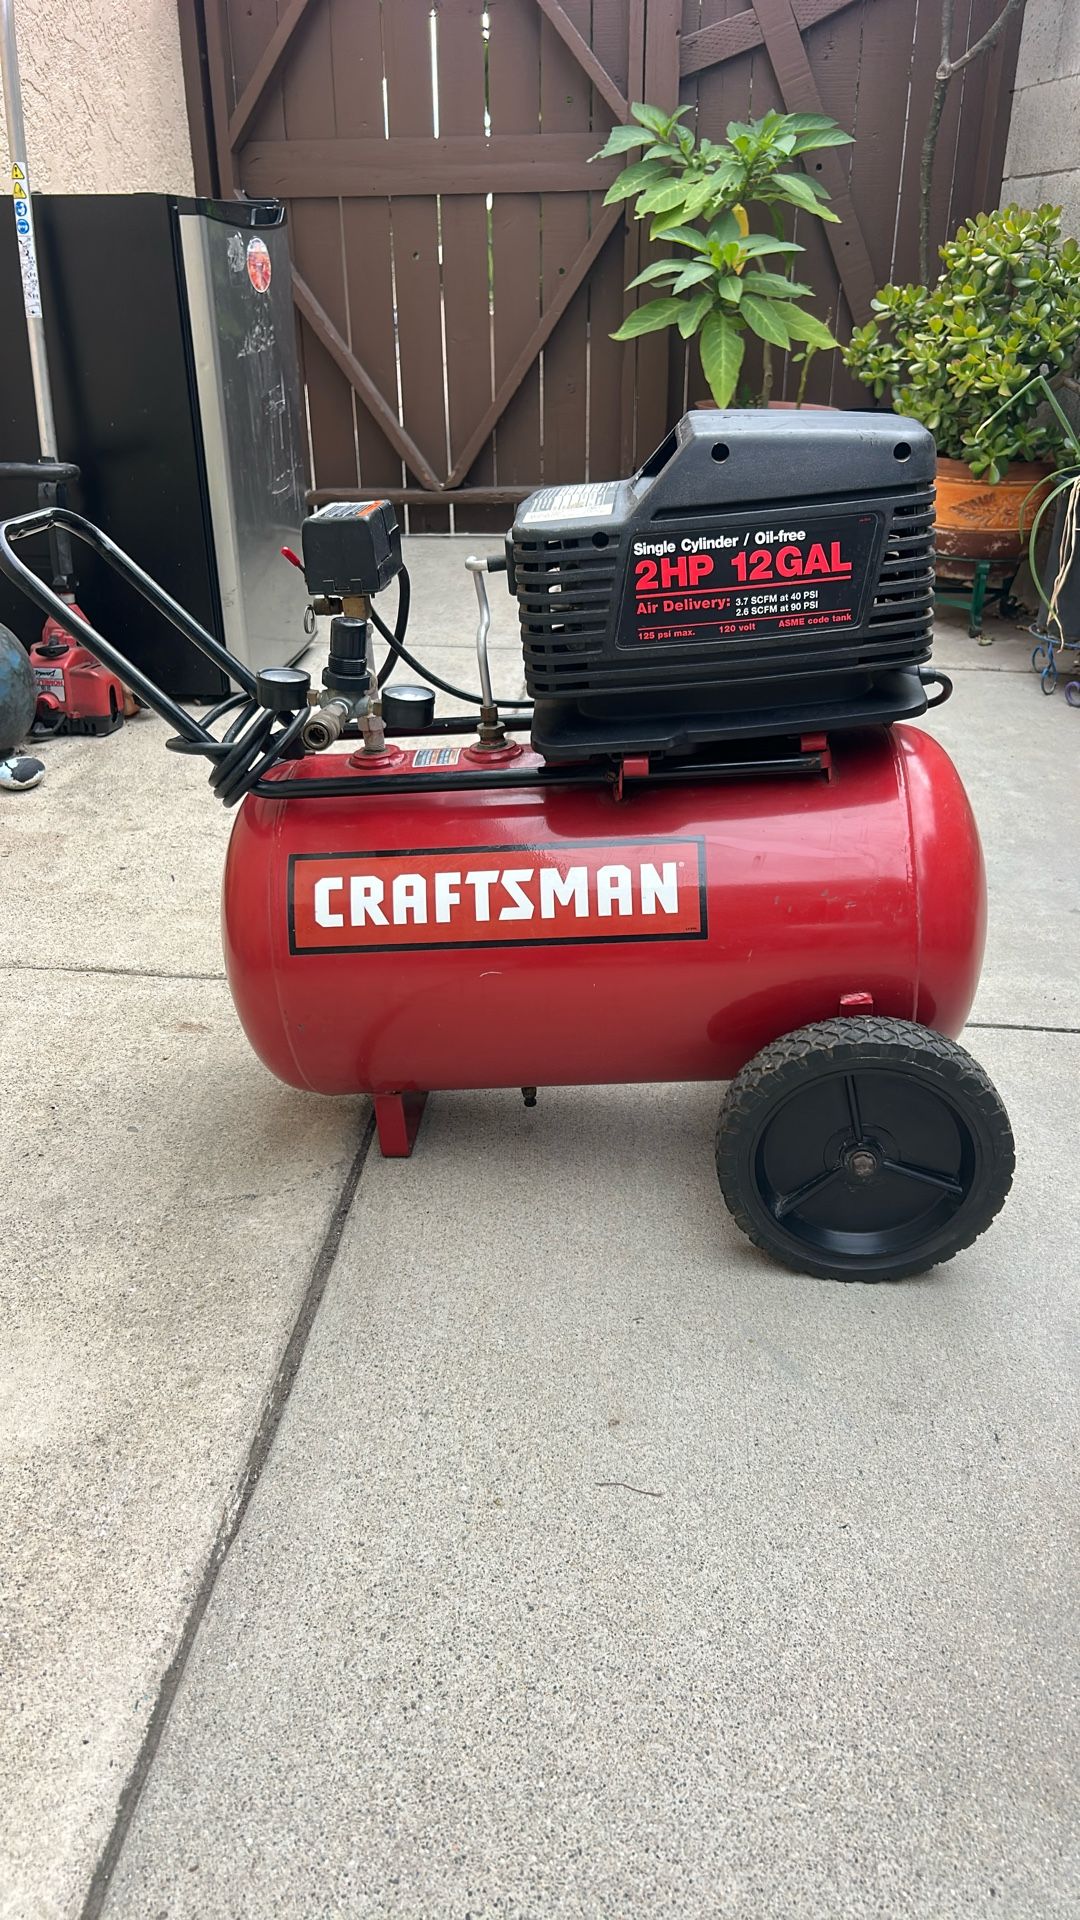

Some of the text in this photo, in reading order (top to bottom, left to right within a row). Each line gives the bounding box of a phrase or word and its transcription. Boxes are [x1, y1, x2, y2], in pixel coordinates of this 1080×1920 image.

[633, 530, 806, 556] Single Cylinder / Oil-free
[635, 541, 852, 590] 2HP 12GAL
[636, 590, 819, 614] Air Delivery: 3.7 SCFM at 40 PSI
[735, 601, 819, 617] 2.6 SCFM at 90 PSI
[638, 613, 852, 640] 125 psi max. 120 volt ASME code tank
[314, 862, 680, 929] CRAFTSMAN
